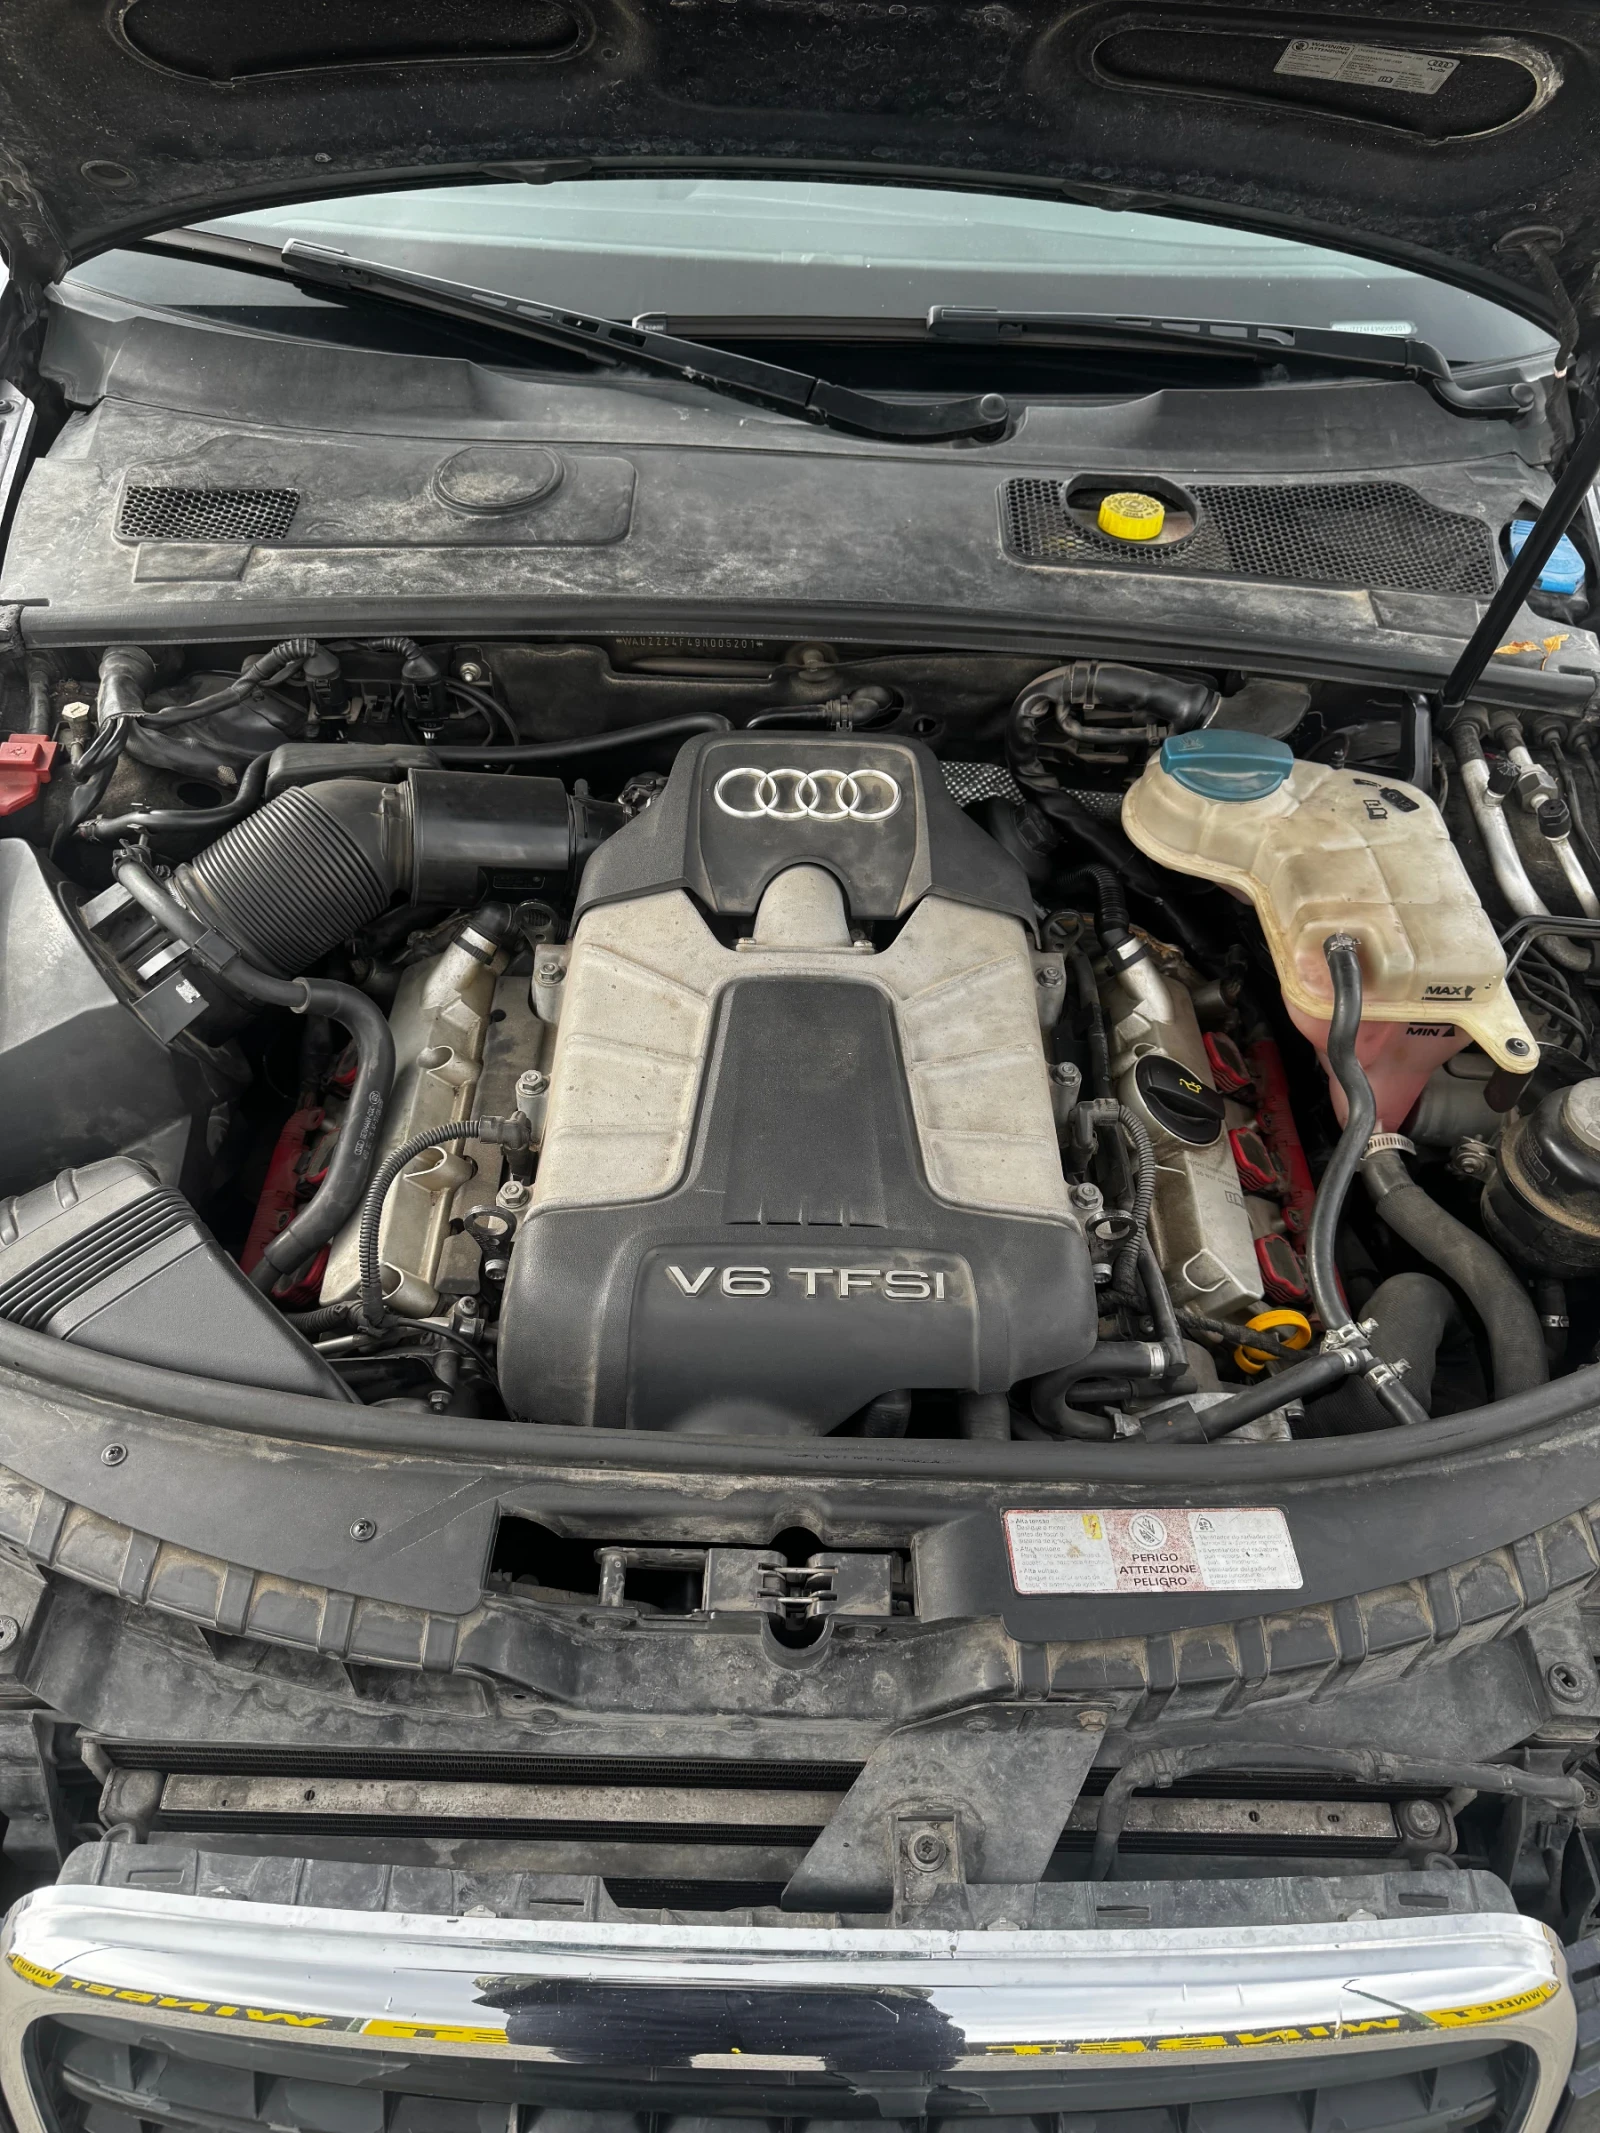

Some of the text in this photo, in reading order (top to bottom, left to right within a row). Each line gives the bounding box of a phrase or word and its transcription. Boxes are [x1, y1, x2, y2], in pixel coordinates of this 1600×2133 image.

[1311, 42, 1351, 51] WARNING
[1425, 985, 1463, 995] MAX
[1406, 1027, 1440, 1036] MIN
[667, 1265, 946, 1301] V6 TFSI
[1132, 1553, 1178, 1562] PERIGO
[1119, 1565, 1197, 1574] ATTENZIONE
[1133, 1577, 1187, 1587] PELIGRO
